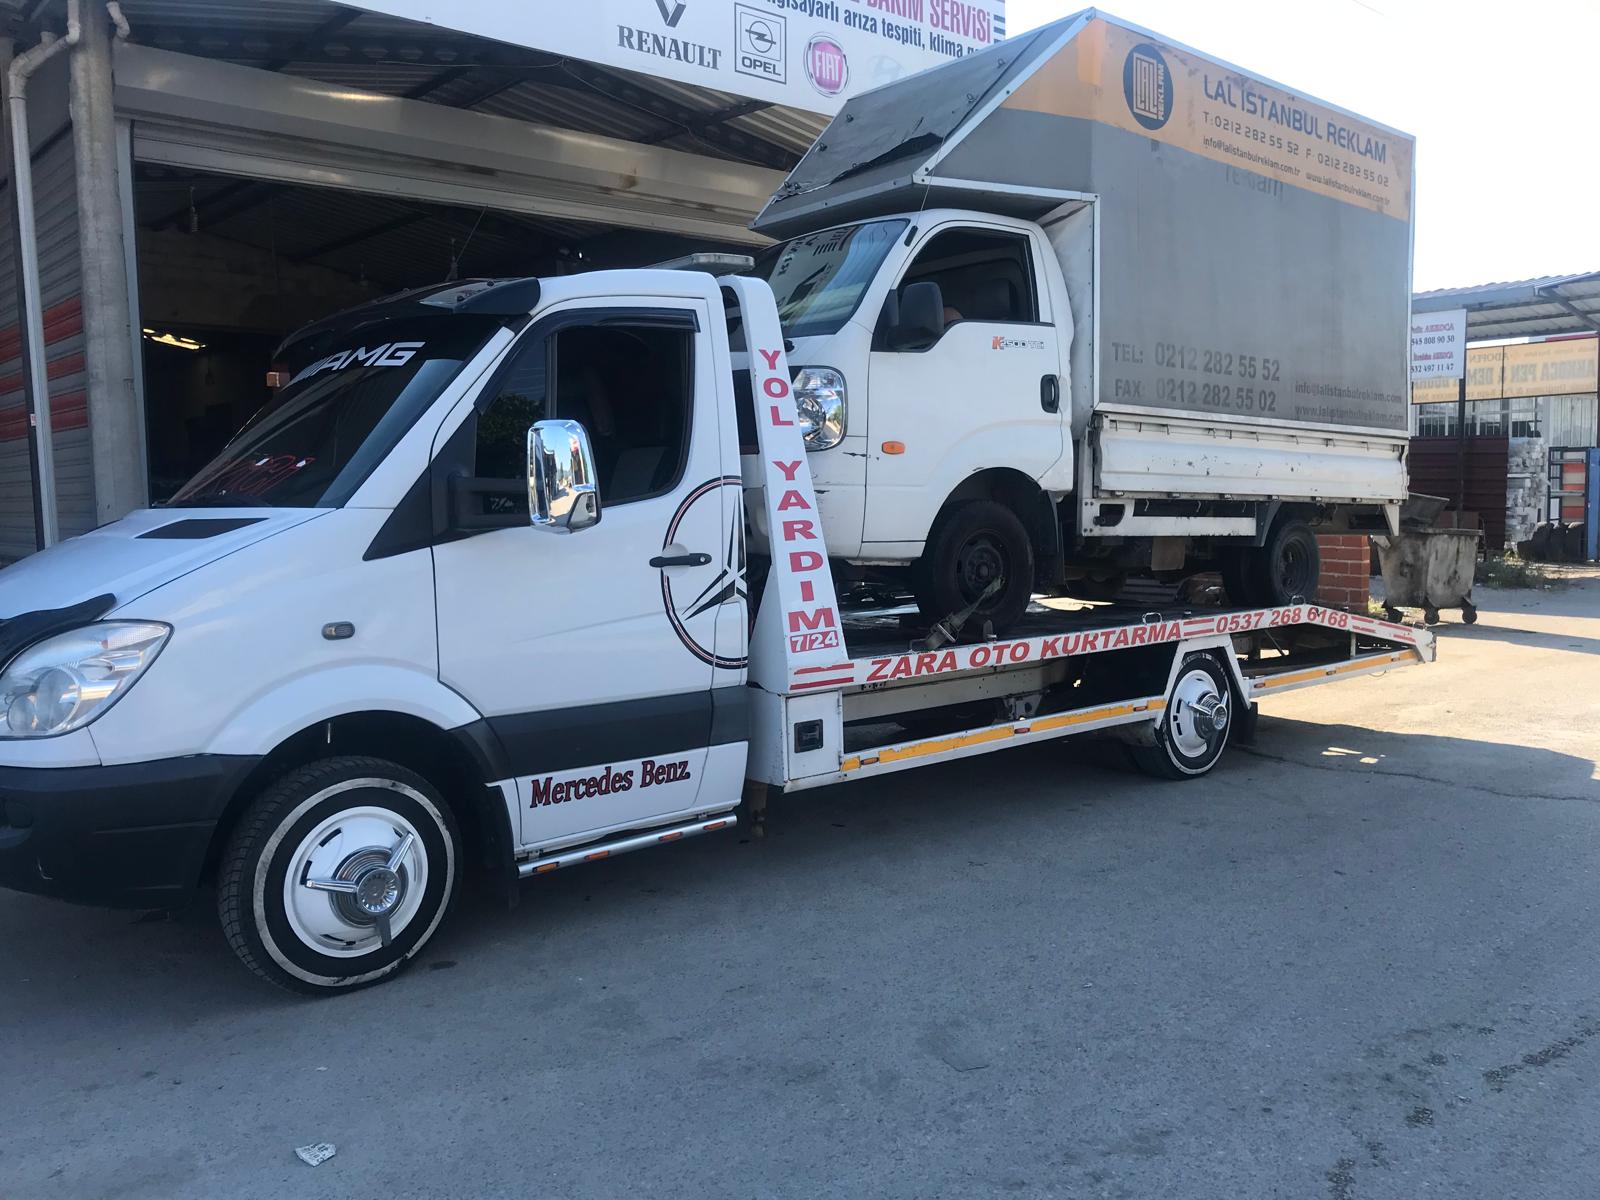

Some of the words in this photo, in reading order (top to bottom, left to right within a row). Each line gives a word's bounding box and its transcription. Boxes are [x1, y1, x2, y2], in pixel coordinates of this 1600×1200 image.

[617, 24, 722, 70] RENAULT
[881, 18, 926, 51] tespiti,
[929, 32, 963, 58] klima
[741, 55, 782, 77] OPEL
[815, 49, 841, 82] FIAT
[1203, 75, 1237, 109] LAL
[1326, 121, 1387, 164] REKLAM
[1244, 126, 1266, 144] 282
[1269, 135, 1283, 149] 55
[1287, 140, 1300, 156] 52
[1317, 152, 1340, 169] 0212
[1342, 161, 1361, 177] 282
[1363, 168, 1375, 182] 55
[1377, 174, 1390, 187] 02
[311, 341, 426, 378] AMG
[1111, 341, 1144, 364] TEL:
[1154, 341, 1198, 371] 0212
[1203, 349, 1233, 376] 282
[1238, 354, 1257, 379] 55
[1261, 358, 1281, 382] 52
[758, 349, 795, 427] YOL
[1155, 377, 1197, 404] 0212
[1202, 382, 1231, 408] 282
[1235, 386, 1254, 410] 55
[1258, 389, 1277, 412] 02
[771, 460, 838, 634] YARDIM
[791, 633, 838, 651] 7/24
[866, 650, 959, 682] ZARA
[969, 641, 1031, 669] OTO
[1215, 611, 1265, 634] 0537
[1269, 606, 1303, 627] 268
[1306, 606, 1340, 629] 6168
[529, 765, 635, 809] Mercedes
[639, 759, 692, 789] Benz
